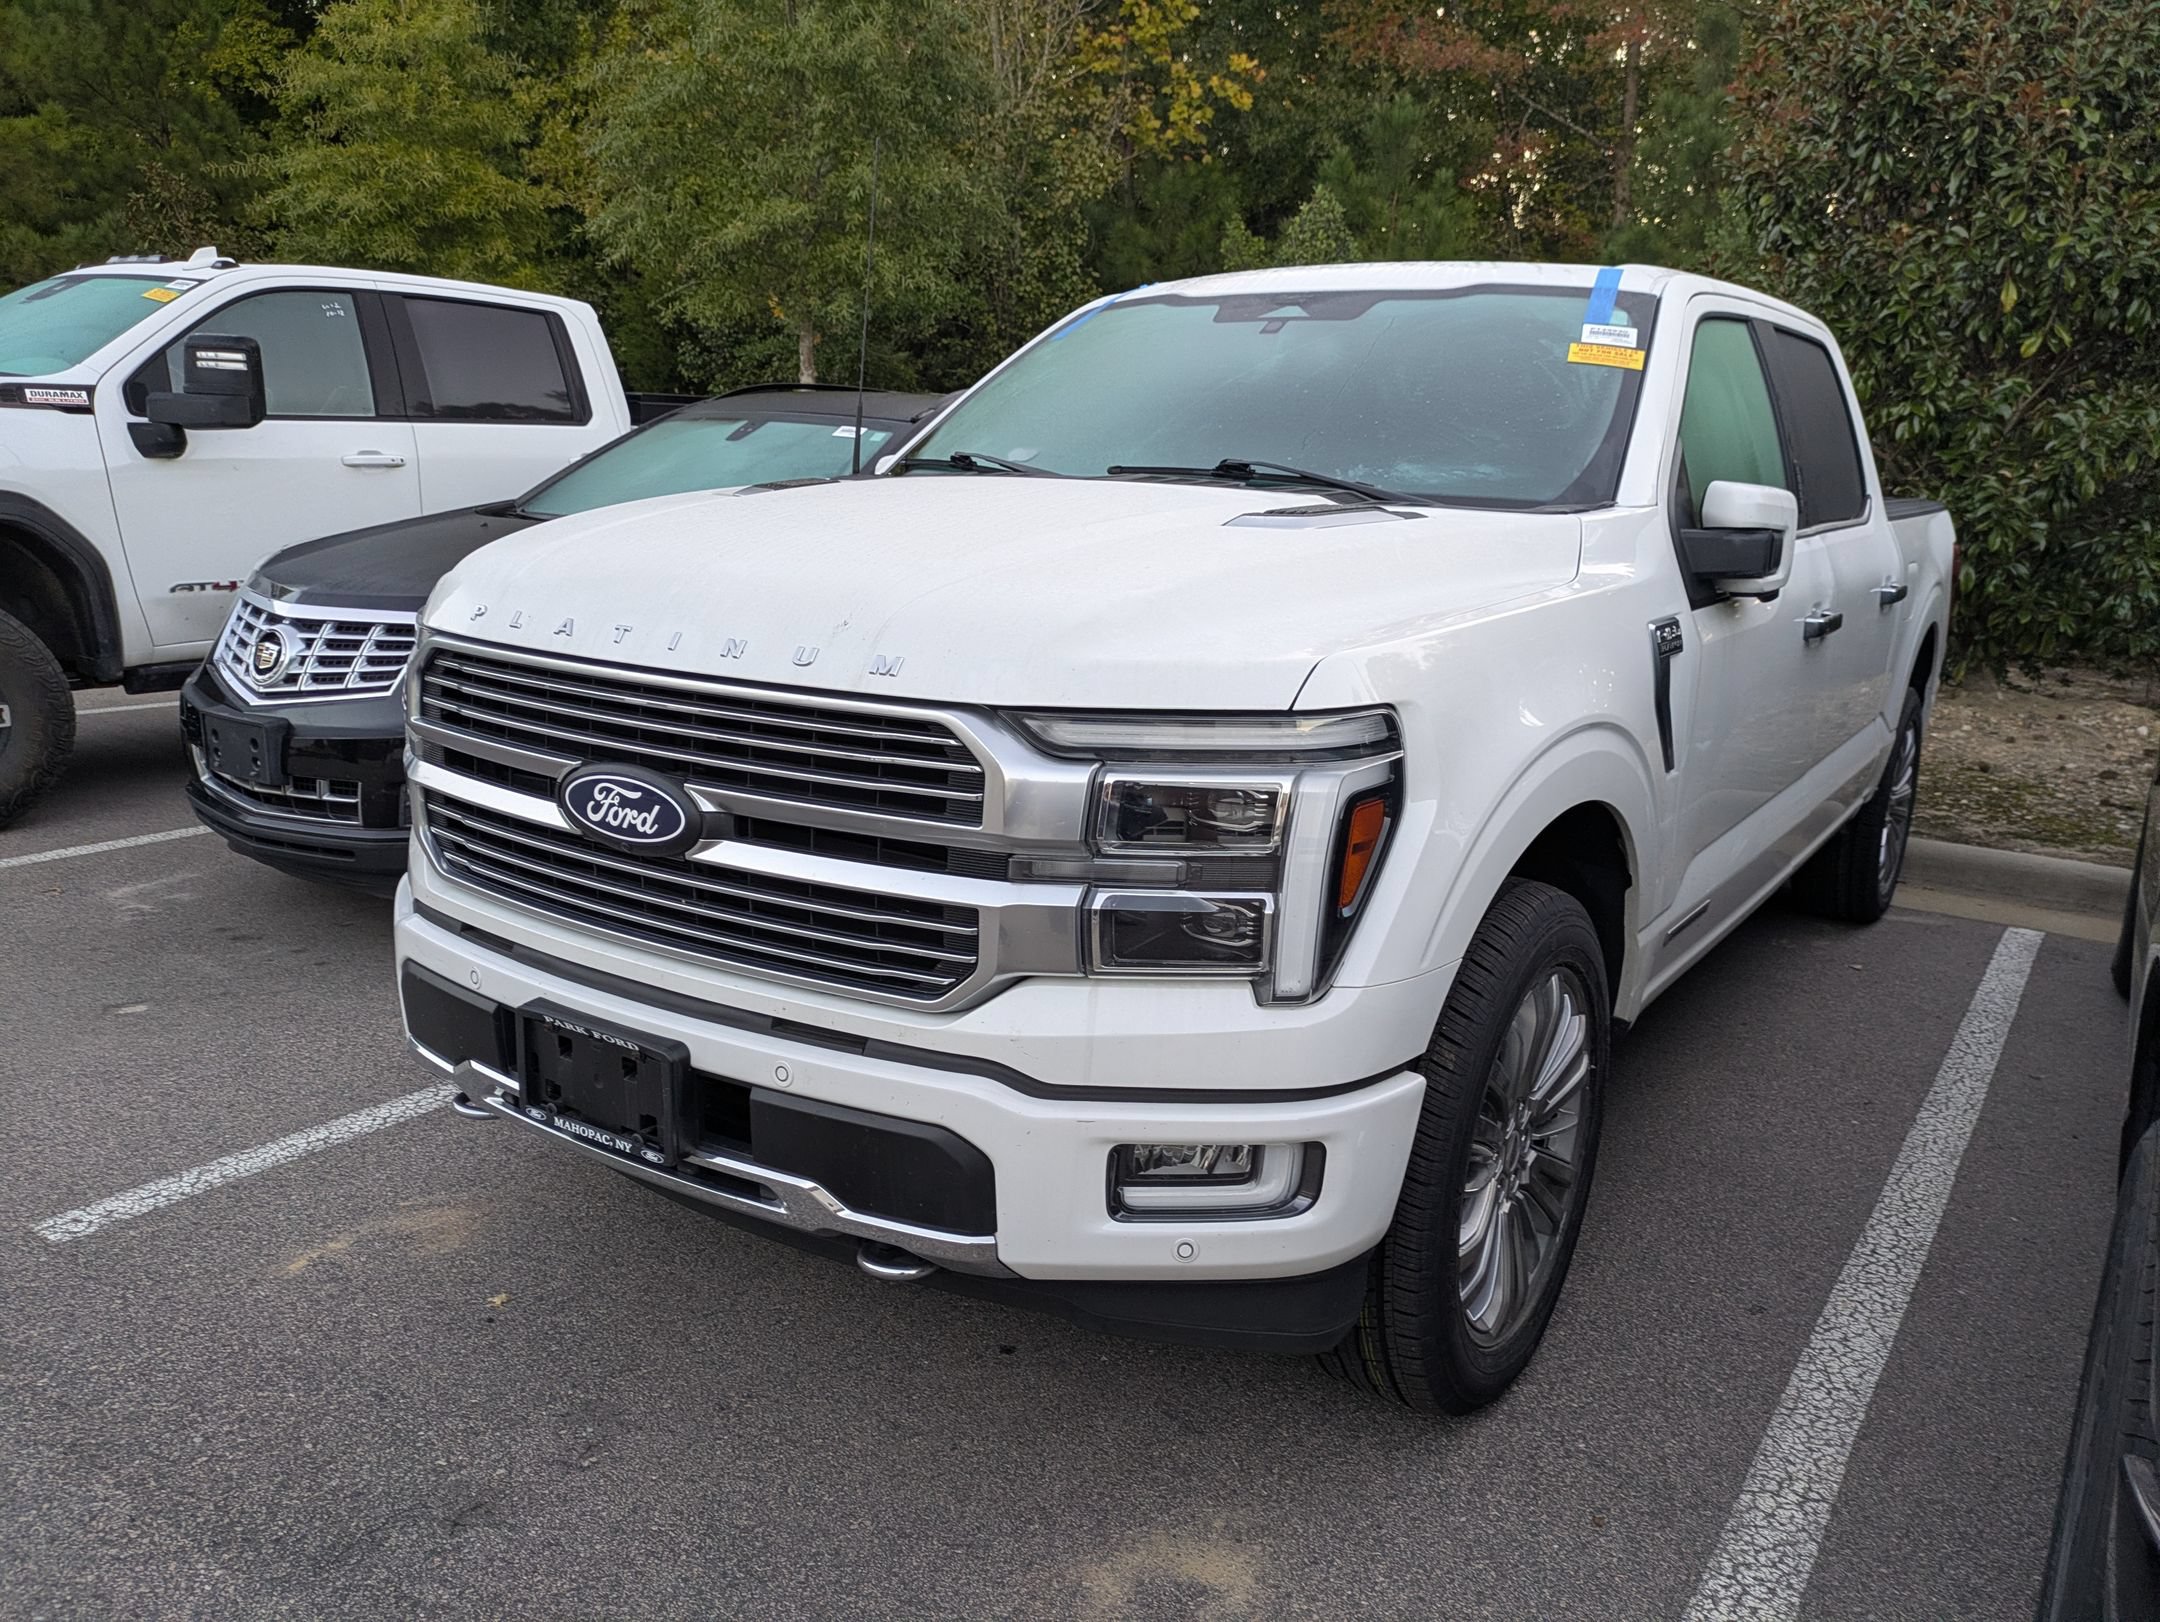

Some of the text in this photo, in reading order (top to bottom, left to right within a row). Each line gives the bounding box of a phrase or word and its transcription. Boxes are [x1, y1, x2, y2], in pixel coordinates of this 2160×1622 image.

[29, 390, 84, 399] DURAMAX
[170, 579, 244, 593] AT4
[469, 603, 905, 678] PLATINUM
[586, 781, 661, 835] Ford
[542, 1014, 640, 1052] PARK FORD
[553, 1115, 633, 1154] MAHOPAC, NY
